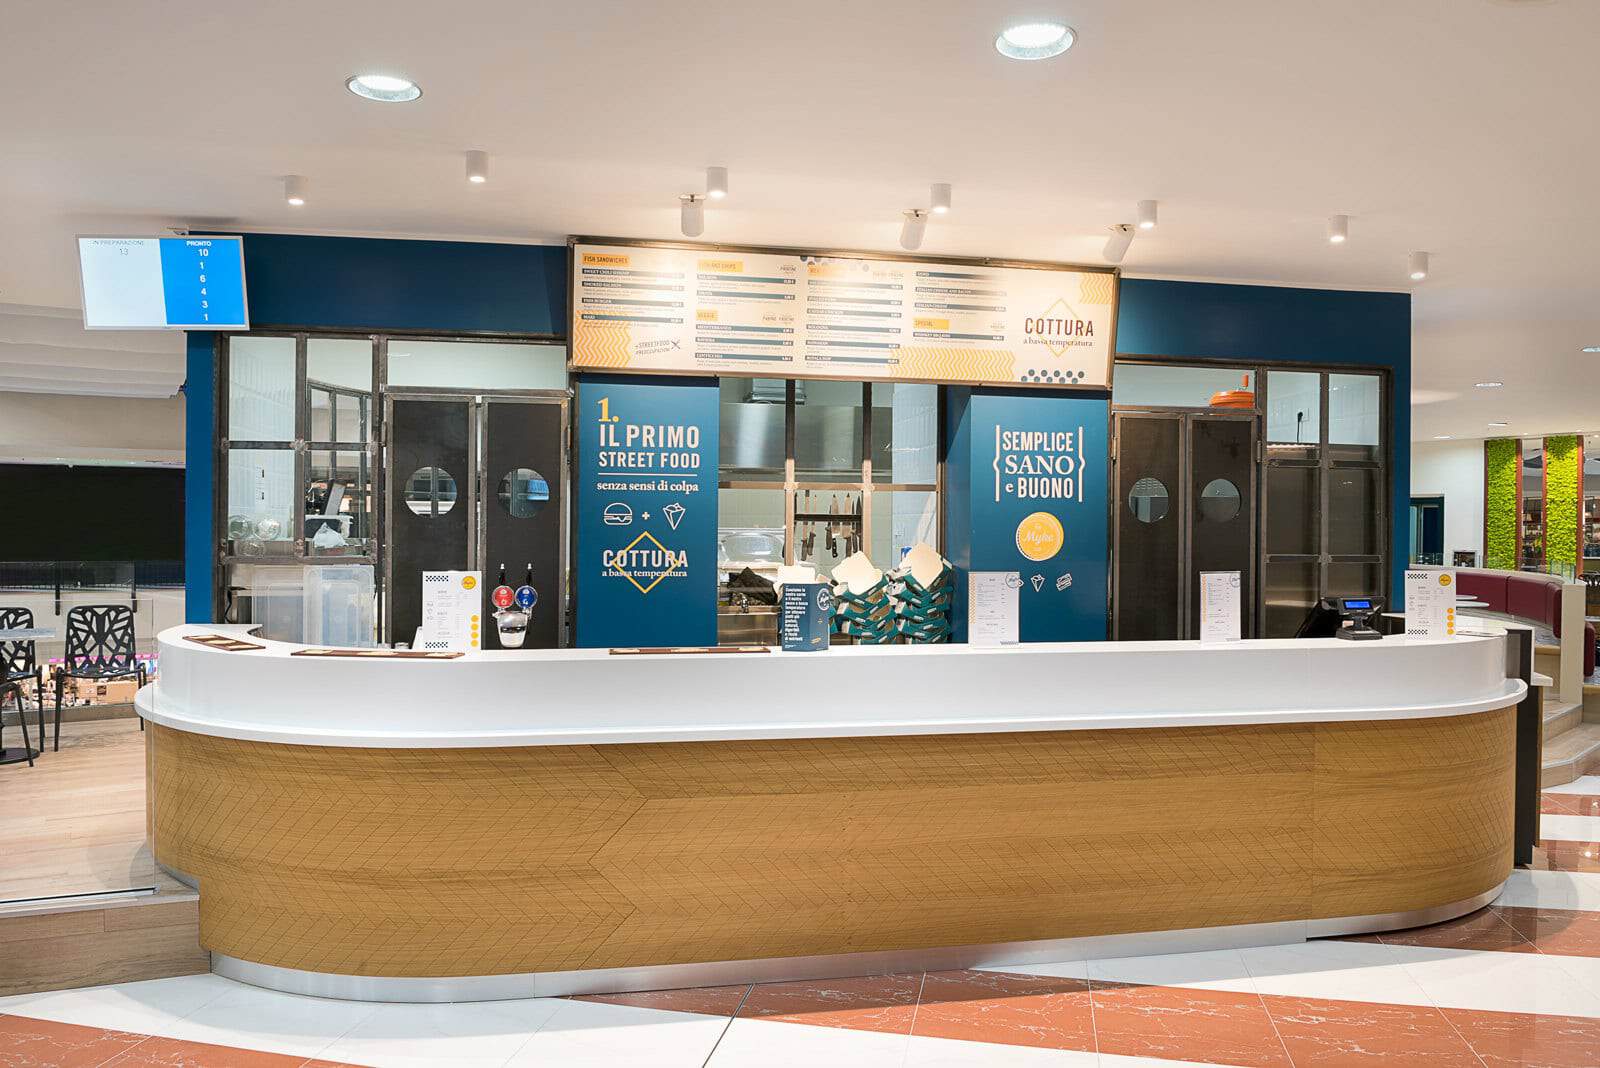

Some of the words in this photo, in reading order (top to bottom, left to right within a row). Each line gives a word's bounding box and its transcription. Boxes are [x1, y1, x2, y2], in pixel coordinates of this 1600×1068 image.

[198, 249, 209, 257] 10
[199, 261, 204, 270] 1
[584, 255, 595, 263] FISH
[596, 256, 628, 264] SANDWICHES
[199, 274, 206, 283] 6
[200, 287, 207, 296] 4
[202, 300, 208, 309] 3
[203, 313, 208, 321] 1
[1024, 317, 1094, 337] COTTURA
[1028, 337, 1047, 345] bassa
[1049, 339, 1093, 348] temperatura
[597, 397, 620, 422] 1.
[600, 424, 620, 447] IL
[626, 424, 700, 449] PRIMO
[1002, 431, 1074, 452] SEMPLICE
[598, 451, 656, 468] STREET
[660, 452, 700, 468] FOOD
[1005, 454, 1075, 475] SANO
[597, 482, 627, 491] senza
[629, 481, 656, 491] sensi
[657, 480, 668, 491] di
[670, 481, 699, 494] colpa
[1005, 482, 1014, 492] e
[1017, 477, 1074, 498] BUONO
[602, 549, 688, 568] COTTURA
[608, 568, 632, 577] bassa
[633, 570, 688, 579] temperatura
